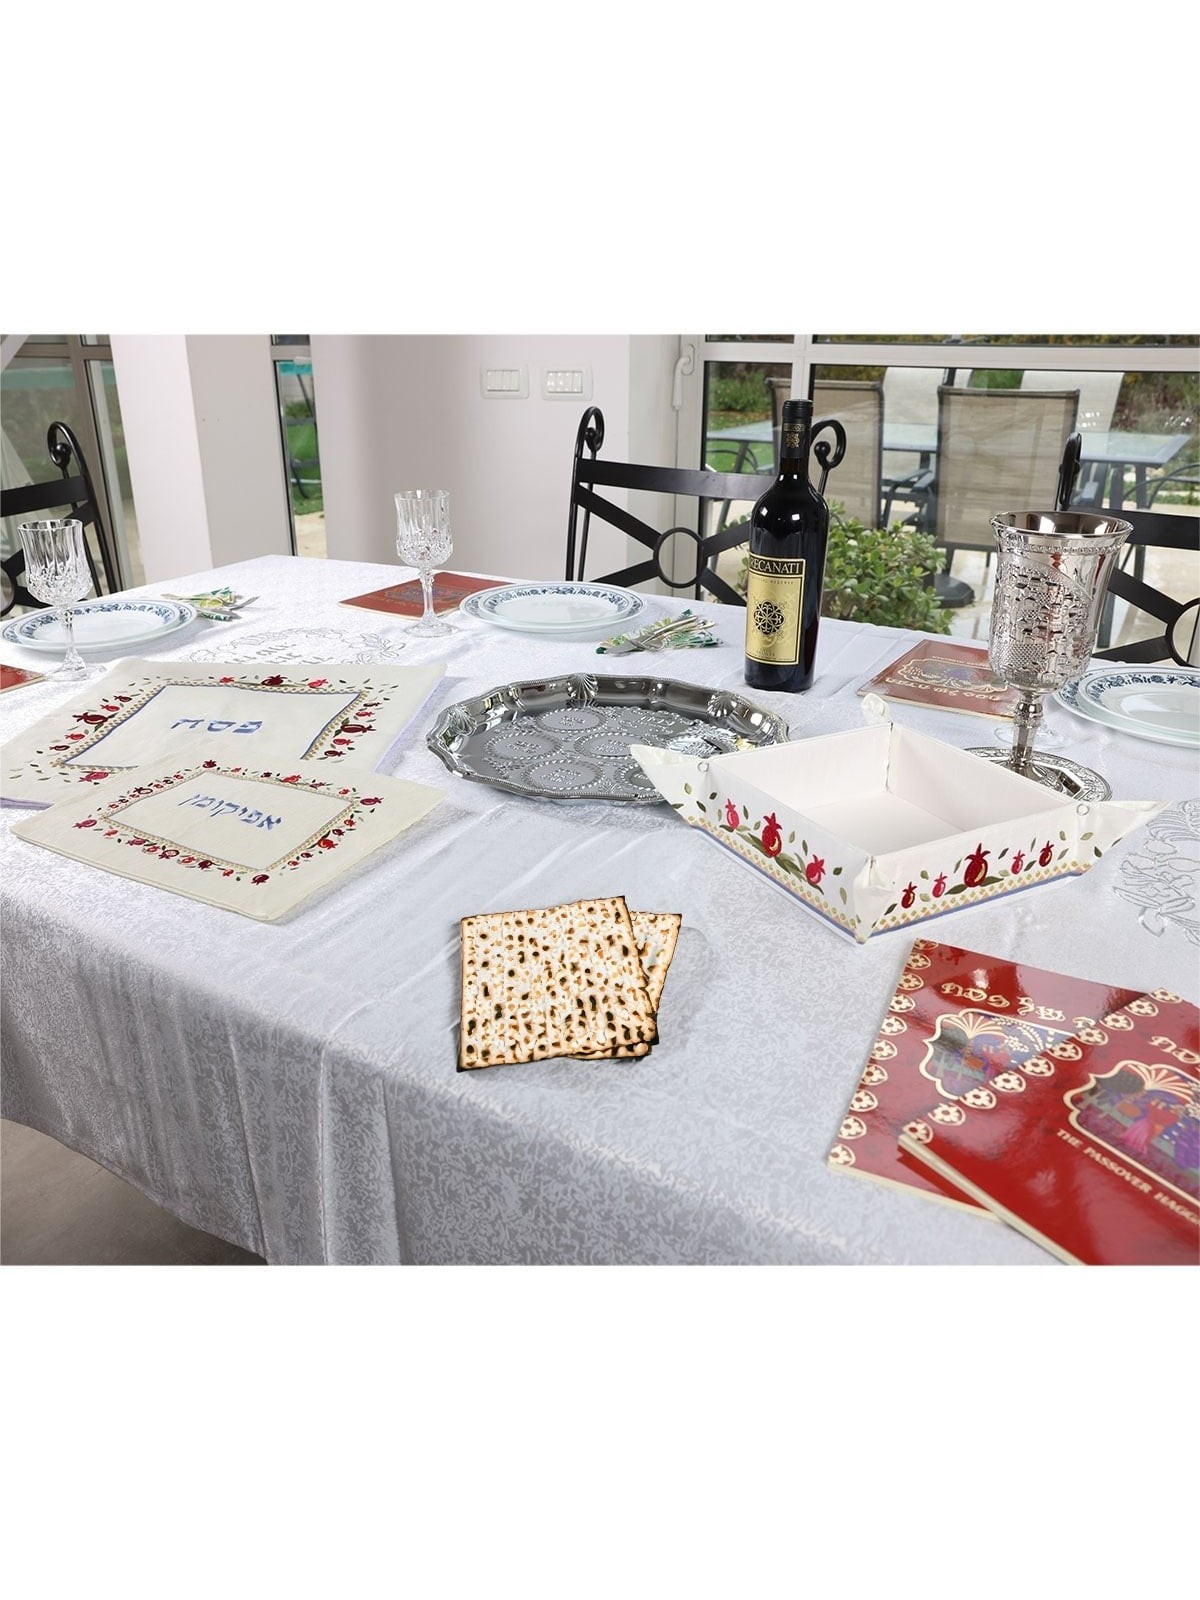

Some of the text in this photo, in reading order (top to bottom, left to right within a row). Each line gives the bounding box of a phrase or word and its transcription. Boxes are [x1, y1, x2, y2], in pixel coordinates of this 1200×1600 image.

[170, 718, 263, 734] פסח
[178, 794, 282, 831] אפיקומן
[941, 982, 1010, 1009] פסח
[1147, 1035, 1200, 1067] סח
[1056, 1128, 1083, 1149] THE
[1083, 1146, 1153, 1194] PASSOVER
